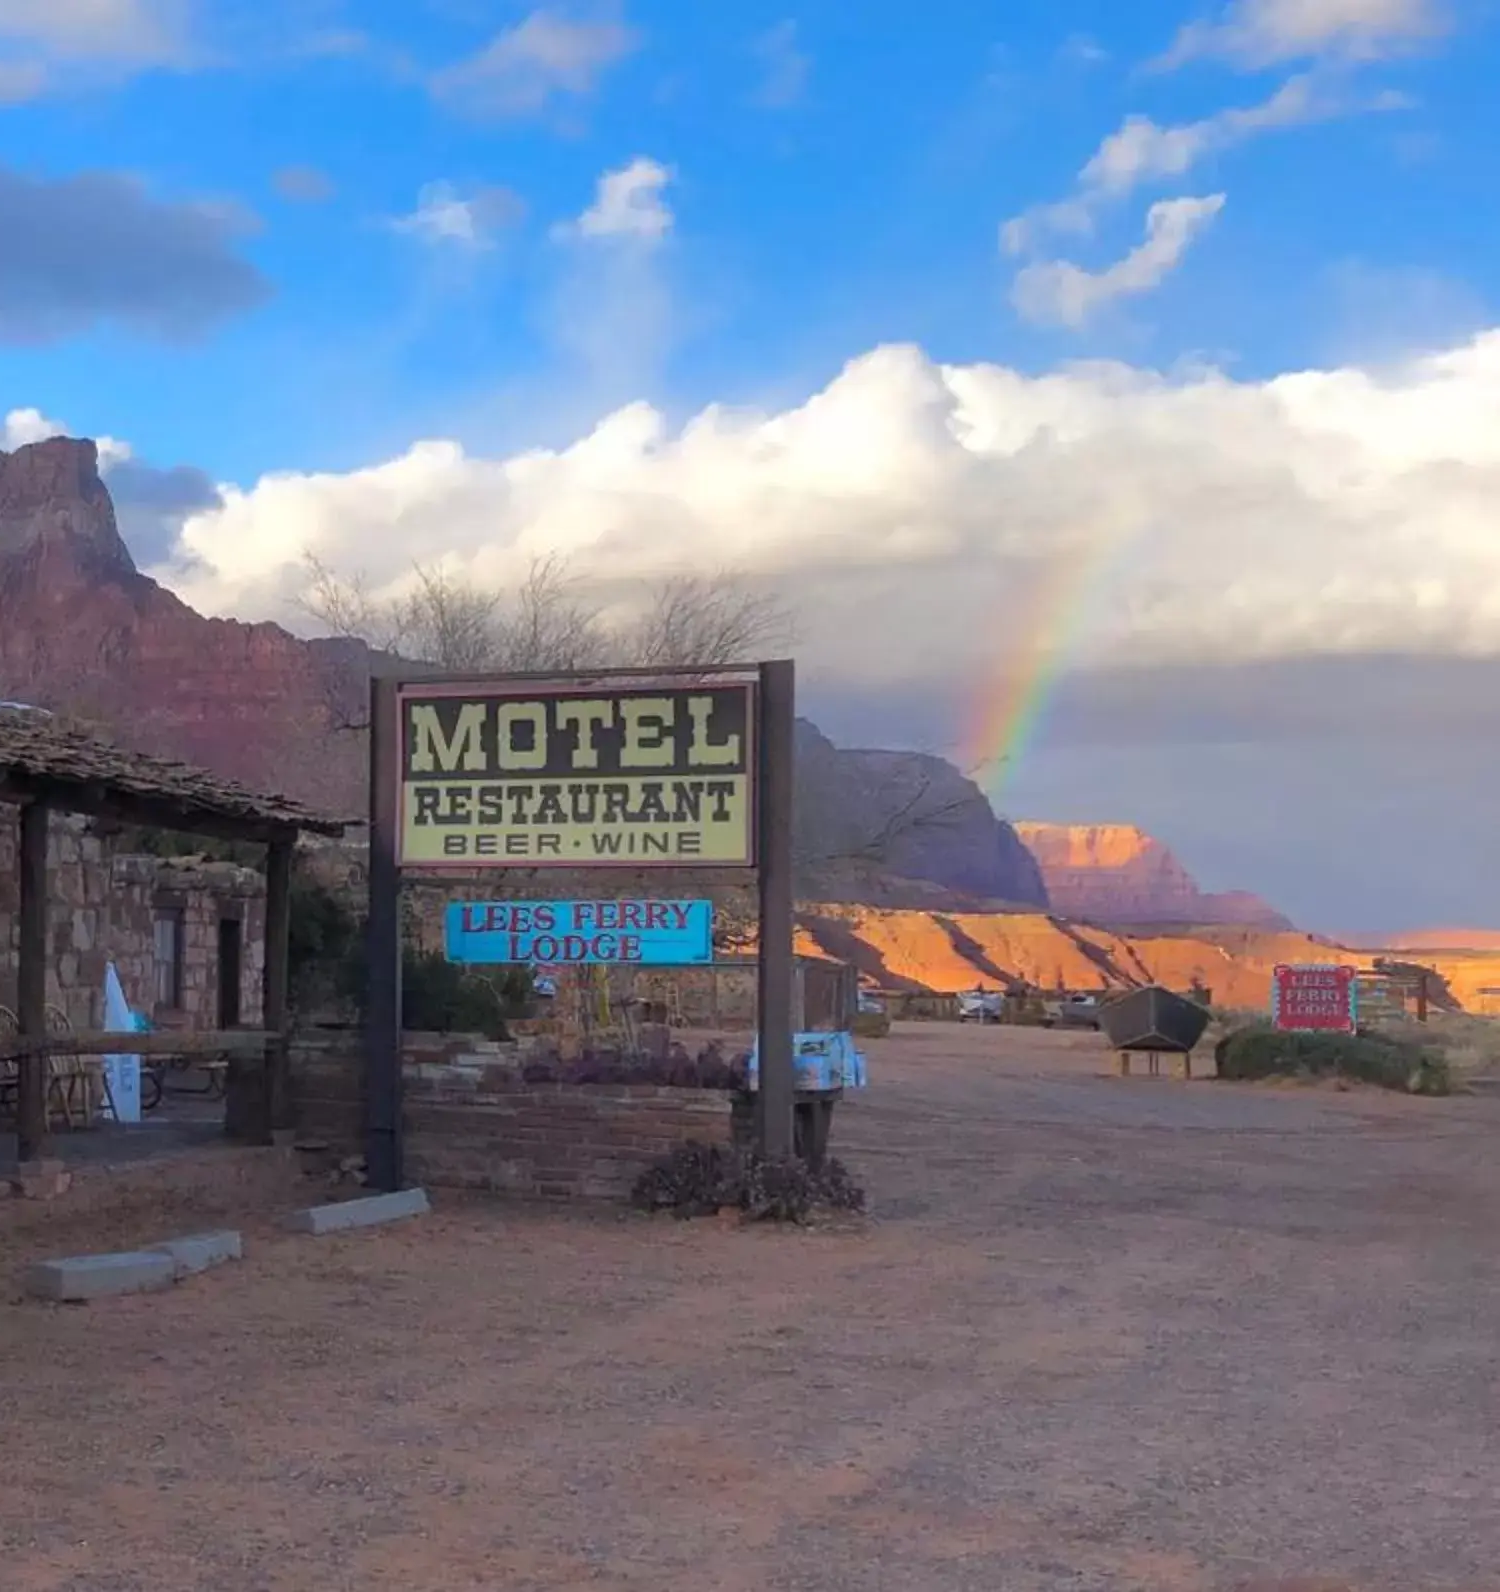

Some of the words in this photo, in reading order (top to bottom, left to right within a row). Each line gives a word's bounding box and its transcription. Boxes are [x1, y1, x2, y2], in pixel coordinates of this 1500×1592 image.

[411, 696, 740, 772] MOTEL
[413, 781, 735, 826] RESTAURANT
[443, 833, 561, 855] BEER
[591, 832, 701, 855] WINE
[461, 905, 556, 932] LEES
[573, 902, 693, 929] FERRY
[509, 934, 643, 961] LODGE
